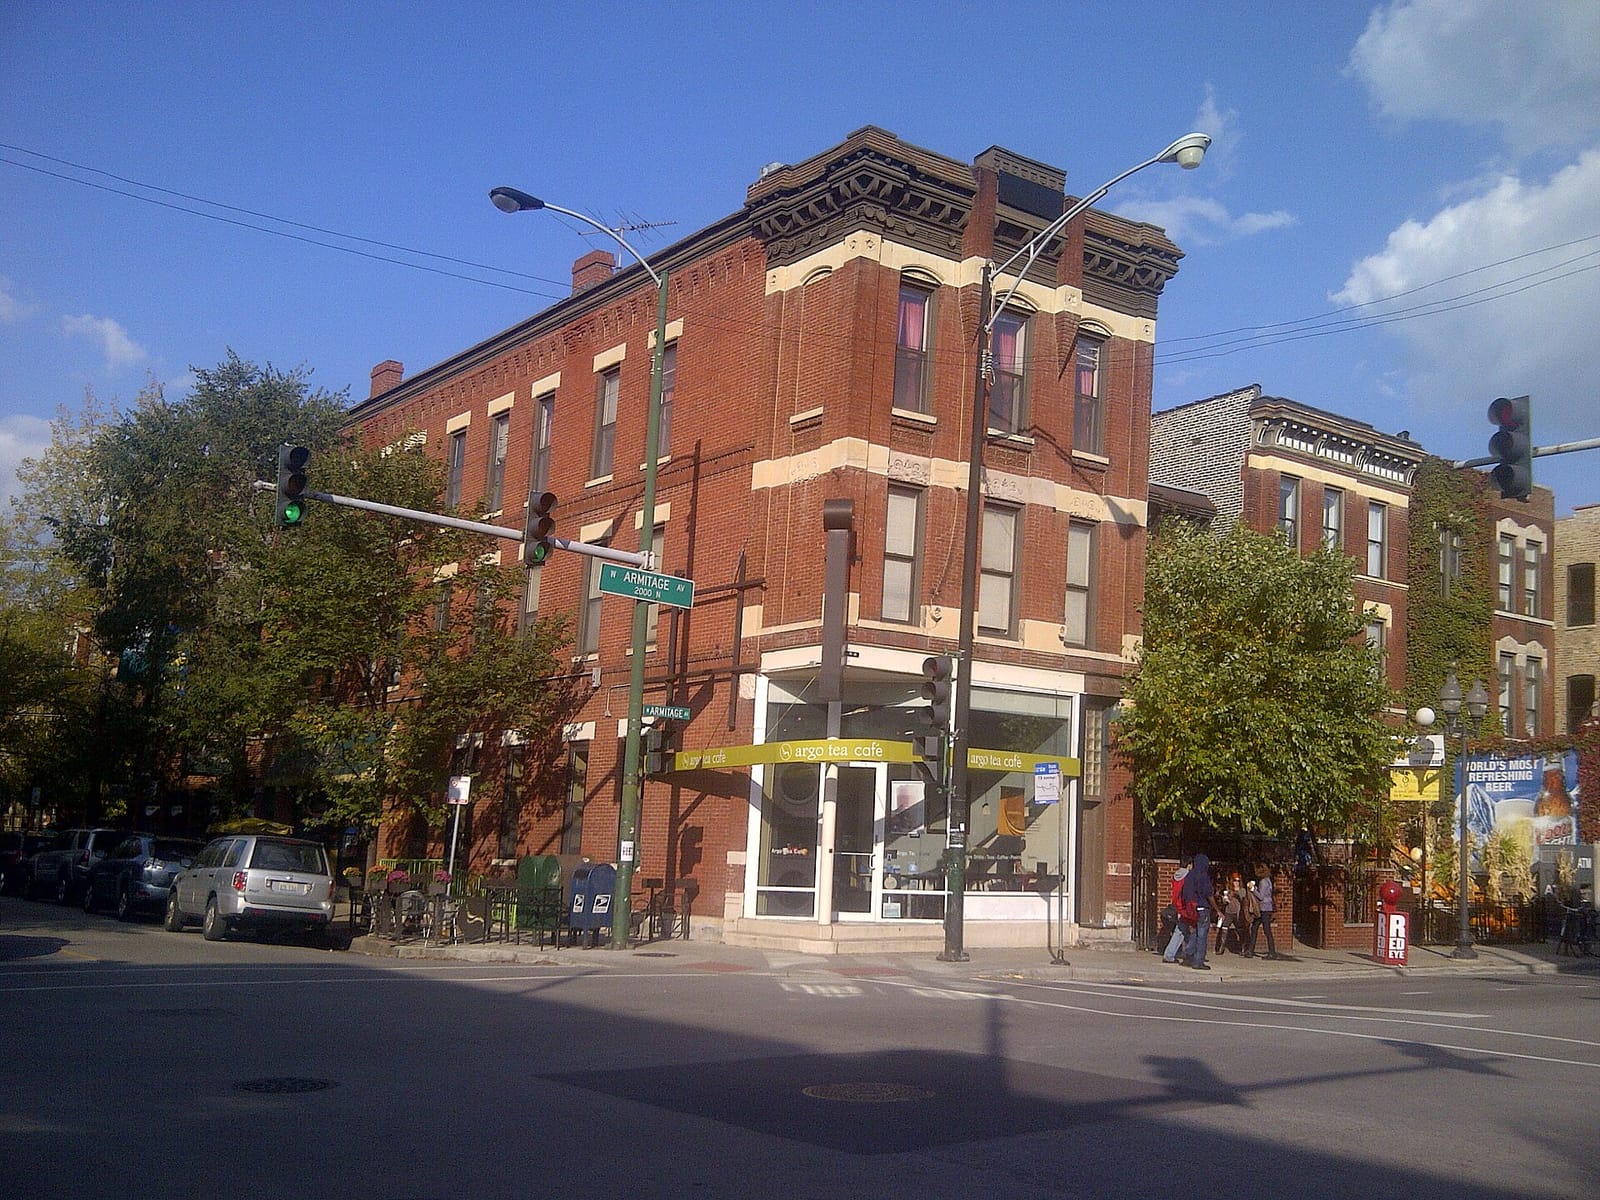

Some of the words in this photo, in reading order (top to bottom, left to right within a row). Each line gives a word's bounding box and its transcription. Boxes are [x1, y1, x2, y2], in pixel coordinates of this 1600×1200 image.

[610, 570, 617, 579] W
[623, 572, 670, 591] ARMITAGE
[676, 584, 686, 593] AV
[634, 586, 652, 597] 2000
[650, 706, 683, 718] ARMITAGE
[795, 747, 824, 760] argo
[828, 744, 848, 756] tea
[854, 742, 883, 757] café
[970, 754, 988, 768] argo
[990, 754, 1001, 766] tea
[1465, 760, 1507, 771] ORLD'S
[1469, 771, 1533, 782] REFRESHING
[1577, 857, 1592, 868] ATM
